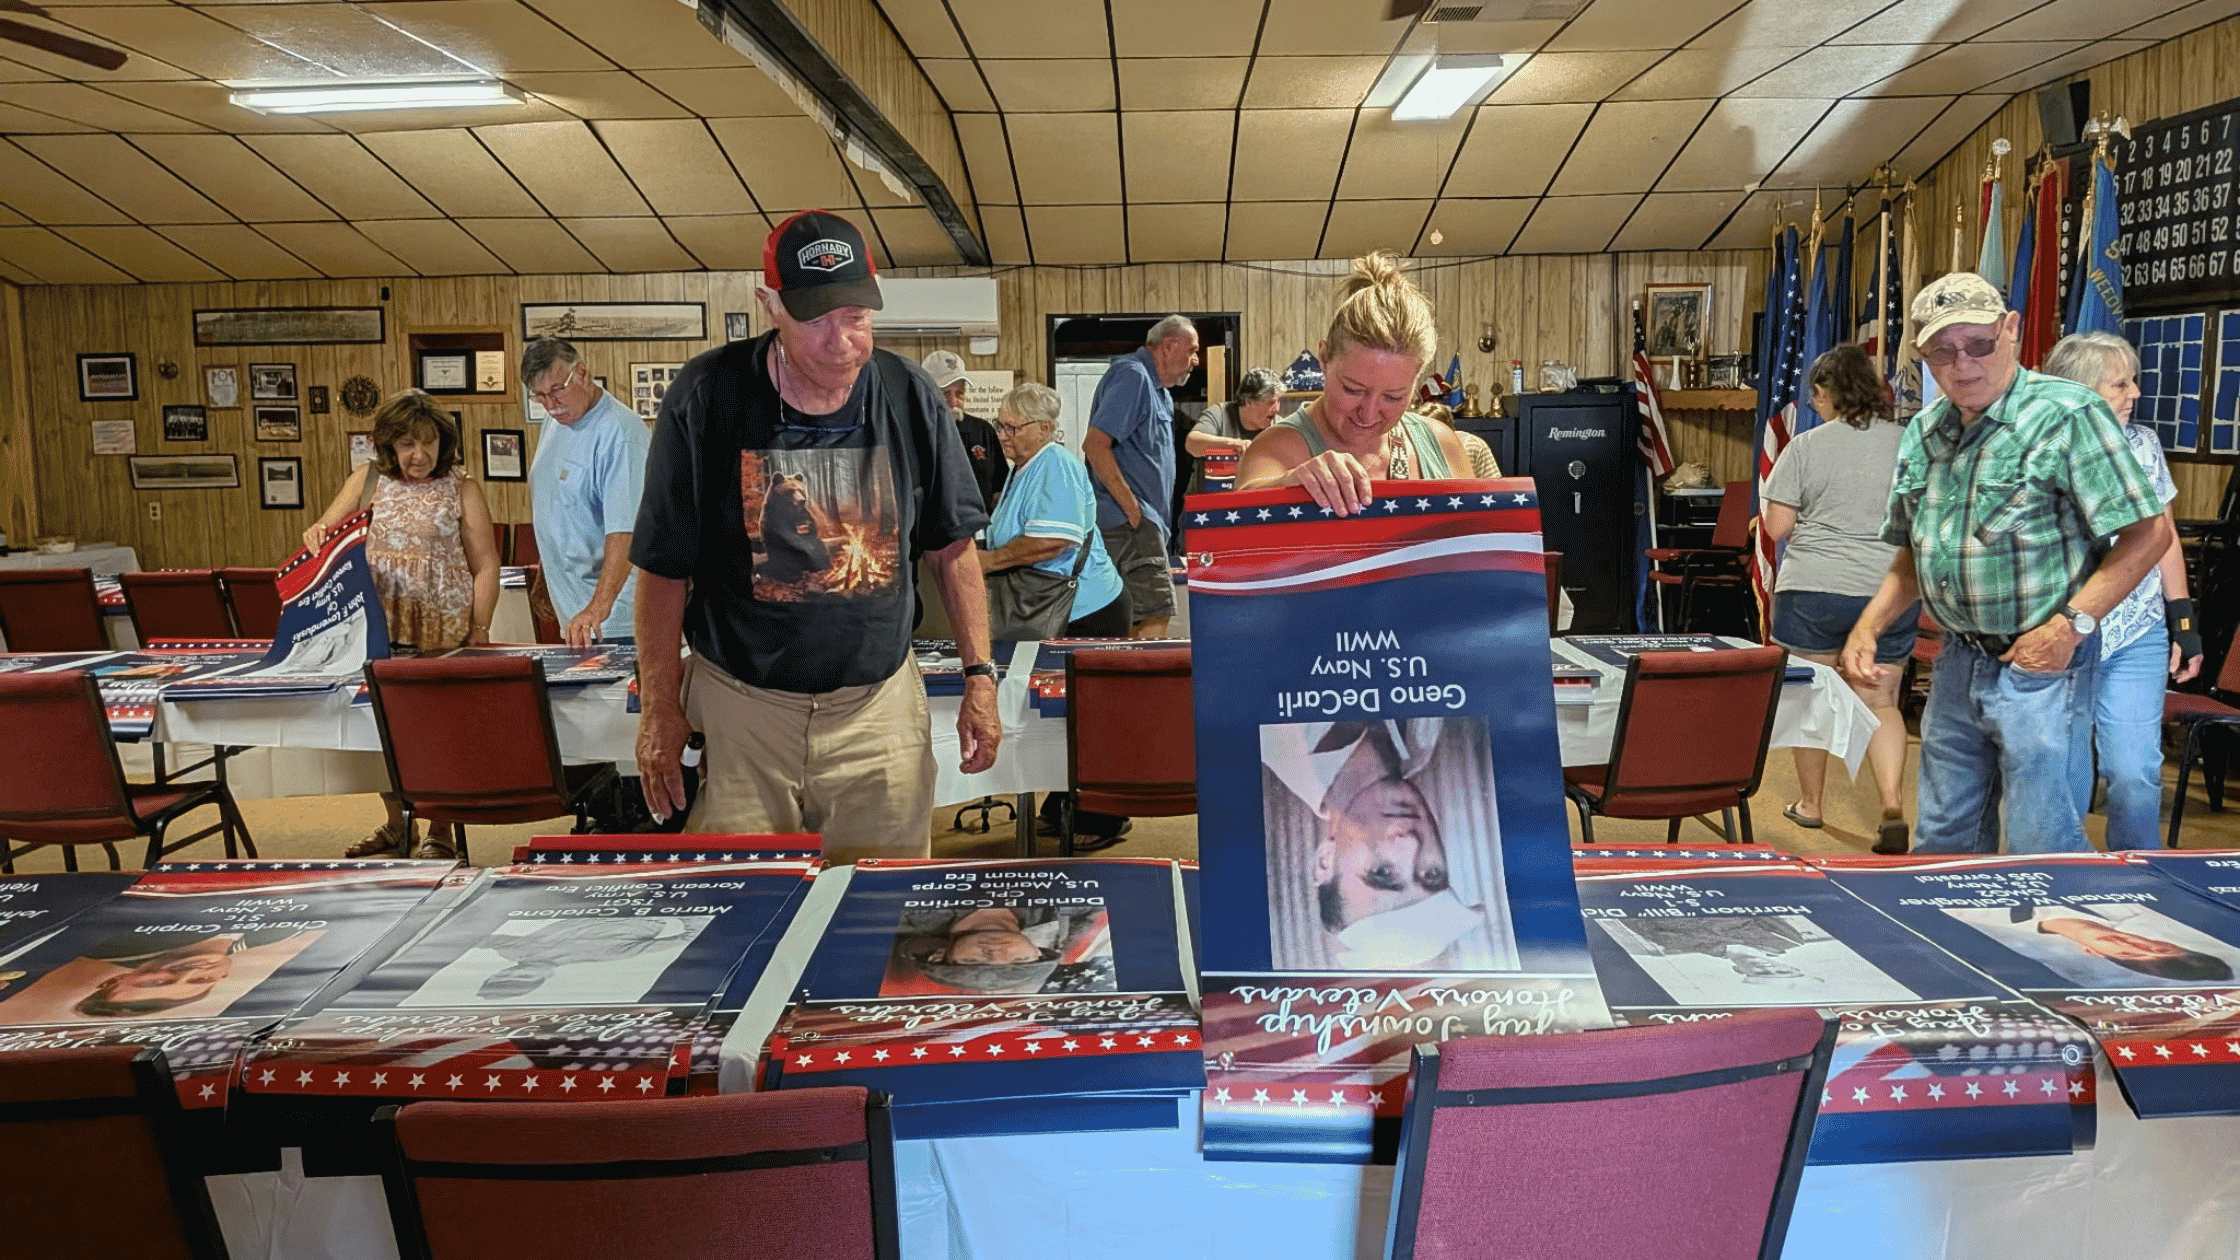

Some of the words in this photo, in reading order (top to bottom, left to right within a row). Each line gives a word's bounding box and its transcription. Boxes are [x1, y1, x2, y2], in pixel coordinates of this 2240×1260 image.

[2128, 140, 2136, 164] 2
[2145, 136, 2154, 158] 3
[2162, 130, 2171, 154] 4
[2181, 126, 2190, 150] 5
[2200, 120, 2210, 144] 6
[2222, 114, 2232, 140] 7
[2124, 171, 2136, 195] 17
[2141, 166, 2154, 192] 18
[2158, 162, 2172, 187] 19
[2175, 157, 2192, 184] 20
[2194, 152, 2211, 179] 21
[2214, 148, 2233, 175] 22
[2120, 202, 2135, 226] 32
[2137, 198, 2152, 224] 33
[2155, 194, 2170, 220] 34
[2172, 190, 2190, 216] 35
[2192, 186, 2210, 212] 36
[2212, 182, 2232, 208] 37
[2120, 233, 2134, 256] 47
[2136, 230, 2150, 254] 48
[2153, 226, 2169, 250] 49
[2172, 222, 2188, 248] 50
[2191, 220, 2207, 246] 51
[2210, 216, 2229, 242] 52
[802, 242, 850, 264] HORNADY
[2134, 262, 2149, 286] 63
[2152, 259, 2167, 284] 64
[2169, 256, 2186, 282] 65
[2188, 254, 2206, 279] 66
[2208, 250, 2228, 276] 67
[1547, 426, 1606, 440] Remington
[332, 560, 353, 581] Korean
[312, 579, 332, 601] Conflict
[331, 582, 344, 597] U.S.
[298, 596, 310, 608] Era
[315, 592, 331, 610] Army
[347, 591, 365, 610] John
[326, 600, 338, 616] Cpl
[292, 610, 341, 644] Lovenduski
[1336, 630, 1400, 652] WWII
[1310, 656, 1371, 680] Navy
[1380, 656, 1427, 678] U.S.
[1278, 688, 1380, 717] DeCarli
[1390, 684, 1466, 709] Geno
[944, 872, 977, 882] Era
[985, 872, 1069, 880] Vietnam
[1914, 873, 2008, 884] Forrestal
[2008, 872, 2054, 880] USS
[544, 885, 578, 894] Era
[584, 884, 664, 892] Conflict
[672, 882, 746, 890] Korean
[911, 882, 972, 892] Corps
[980, 881, 1052, 890] Marine
[1060, 880, 1099, 889] U.S.
[1948, 882, 2003, 890] Navy
[2004, 880, 2050, 889] U.S.
[584, 890, 643, 899] Army
[650, 890, 688, 899] U.S.
[1620, 890, 1676, 898] Navy
[1680, 890, 1725, 898] U.S.
[2060, 892, 2158, 902] Michael
[238, 898, 293, 907] WWII
[600, 898, 654, 907] TSGT
[904, 899, 994, 908] Cortina
[1028, 896, 1104, 906] Daniel
[1899, 897, 2020, 907] Gallagher
[2023, 896, 2062, 906] W.
[201, 906, 258, 914] Navy
[508, 908, 620, 917] Catalone
[634, 908, 652, 916] B.
[660, 905, 734, 915] Mario
[1638, 908, 1696, 918] "Bill"
[1701, 905, 1812, 915] Harrison
[134, 922, 221, 934] Carpin
[230, 920, 328, 931] Charles
[1016, 997, 1164, 1012] Honors
[1229, 985, 1414, 1015] Veterans
[1420, 986, 1576, 1017] Honors
[830, 1001, 1007, 1014] Veterans
[1071, 1006, 1142, 1020] Jay
[521, 1011, 673, 1026] Honors
[849, 1010, 1056, 1030] Township
[1484, 1004, 1555, 1035] Jay
[1836, 1006, 1993, 1023] Honors
[556, 1021, 628, 1042] Jay
[1906, 1016, 1990, 1038] Jay
